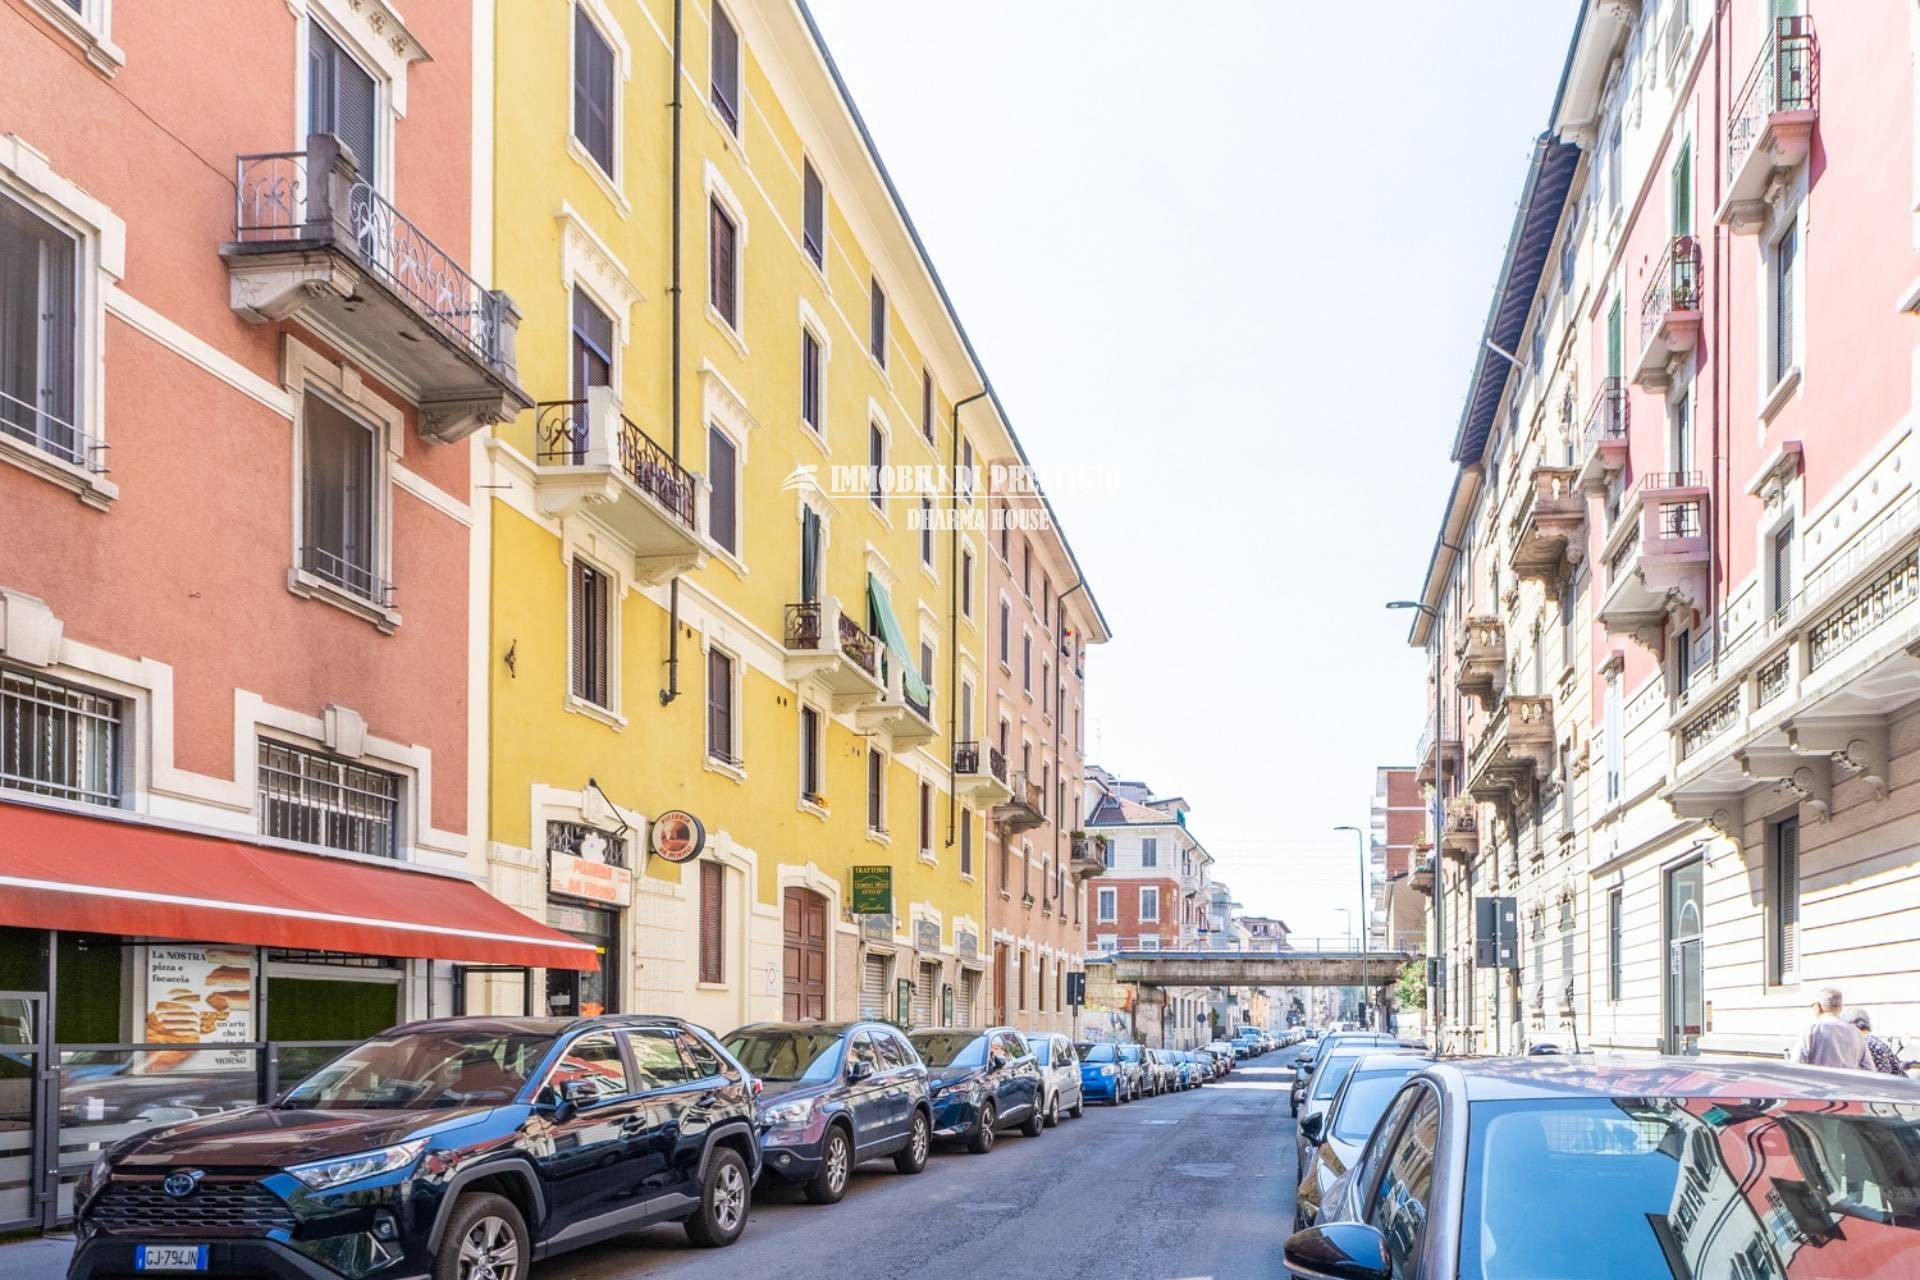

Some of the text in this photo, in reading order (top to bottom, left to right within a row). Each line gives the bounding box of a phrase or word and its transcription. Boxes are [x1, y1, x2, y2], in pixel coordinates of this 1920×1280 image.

[152, 951, 207, 961] La NOSTRA
[152, 963, 176, 972] pizza
[152, 975, 189, 983] focaccia
[215, 1057, 247, 1065] MORSO
